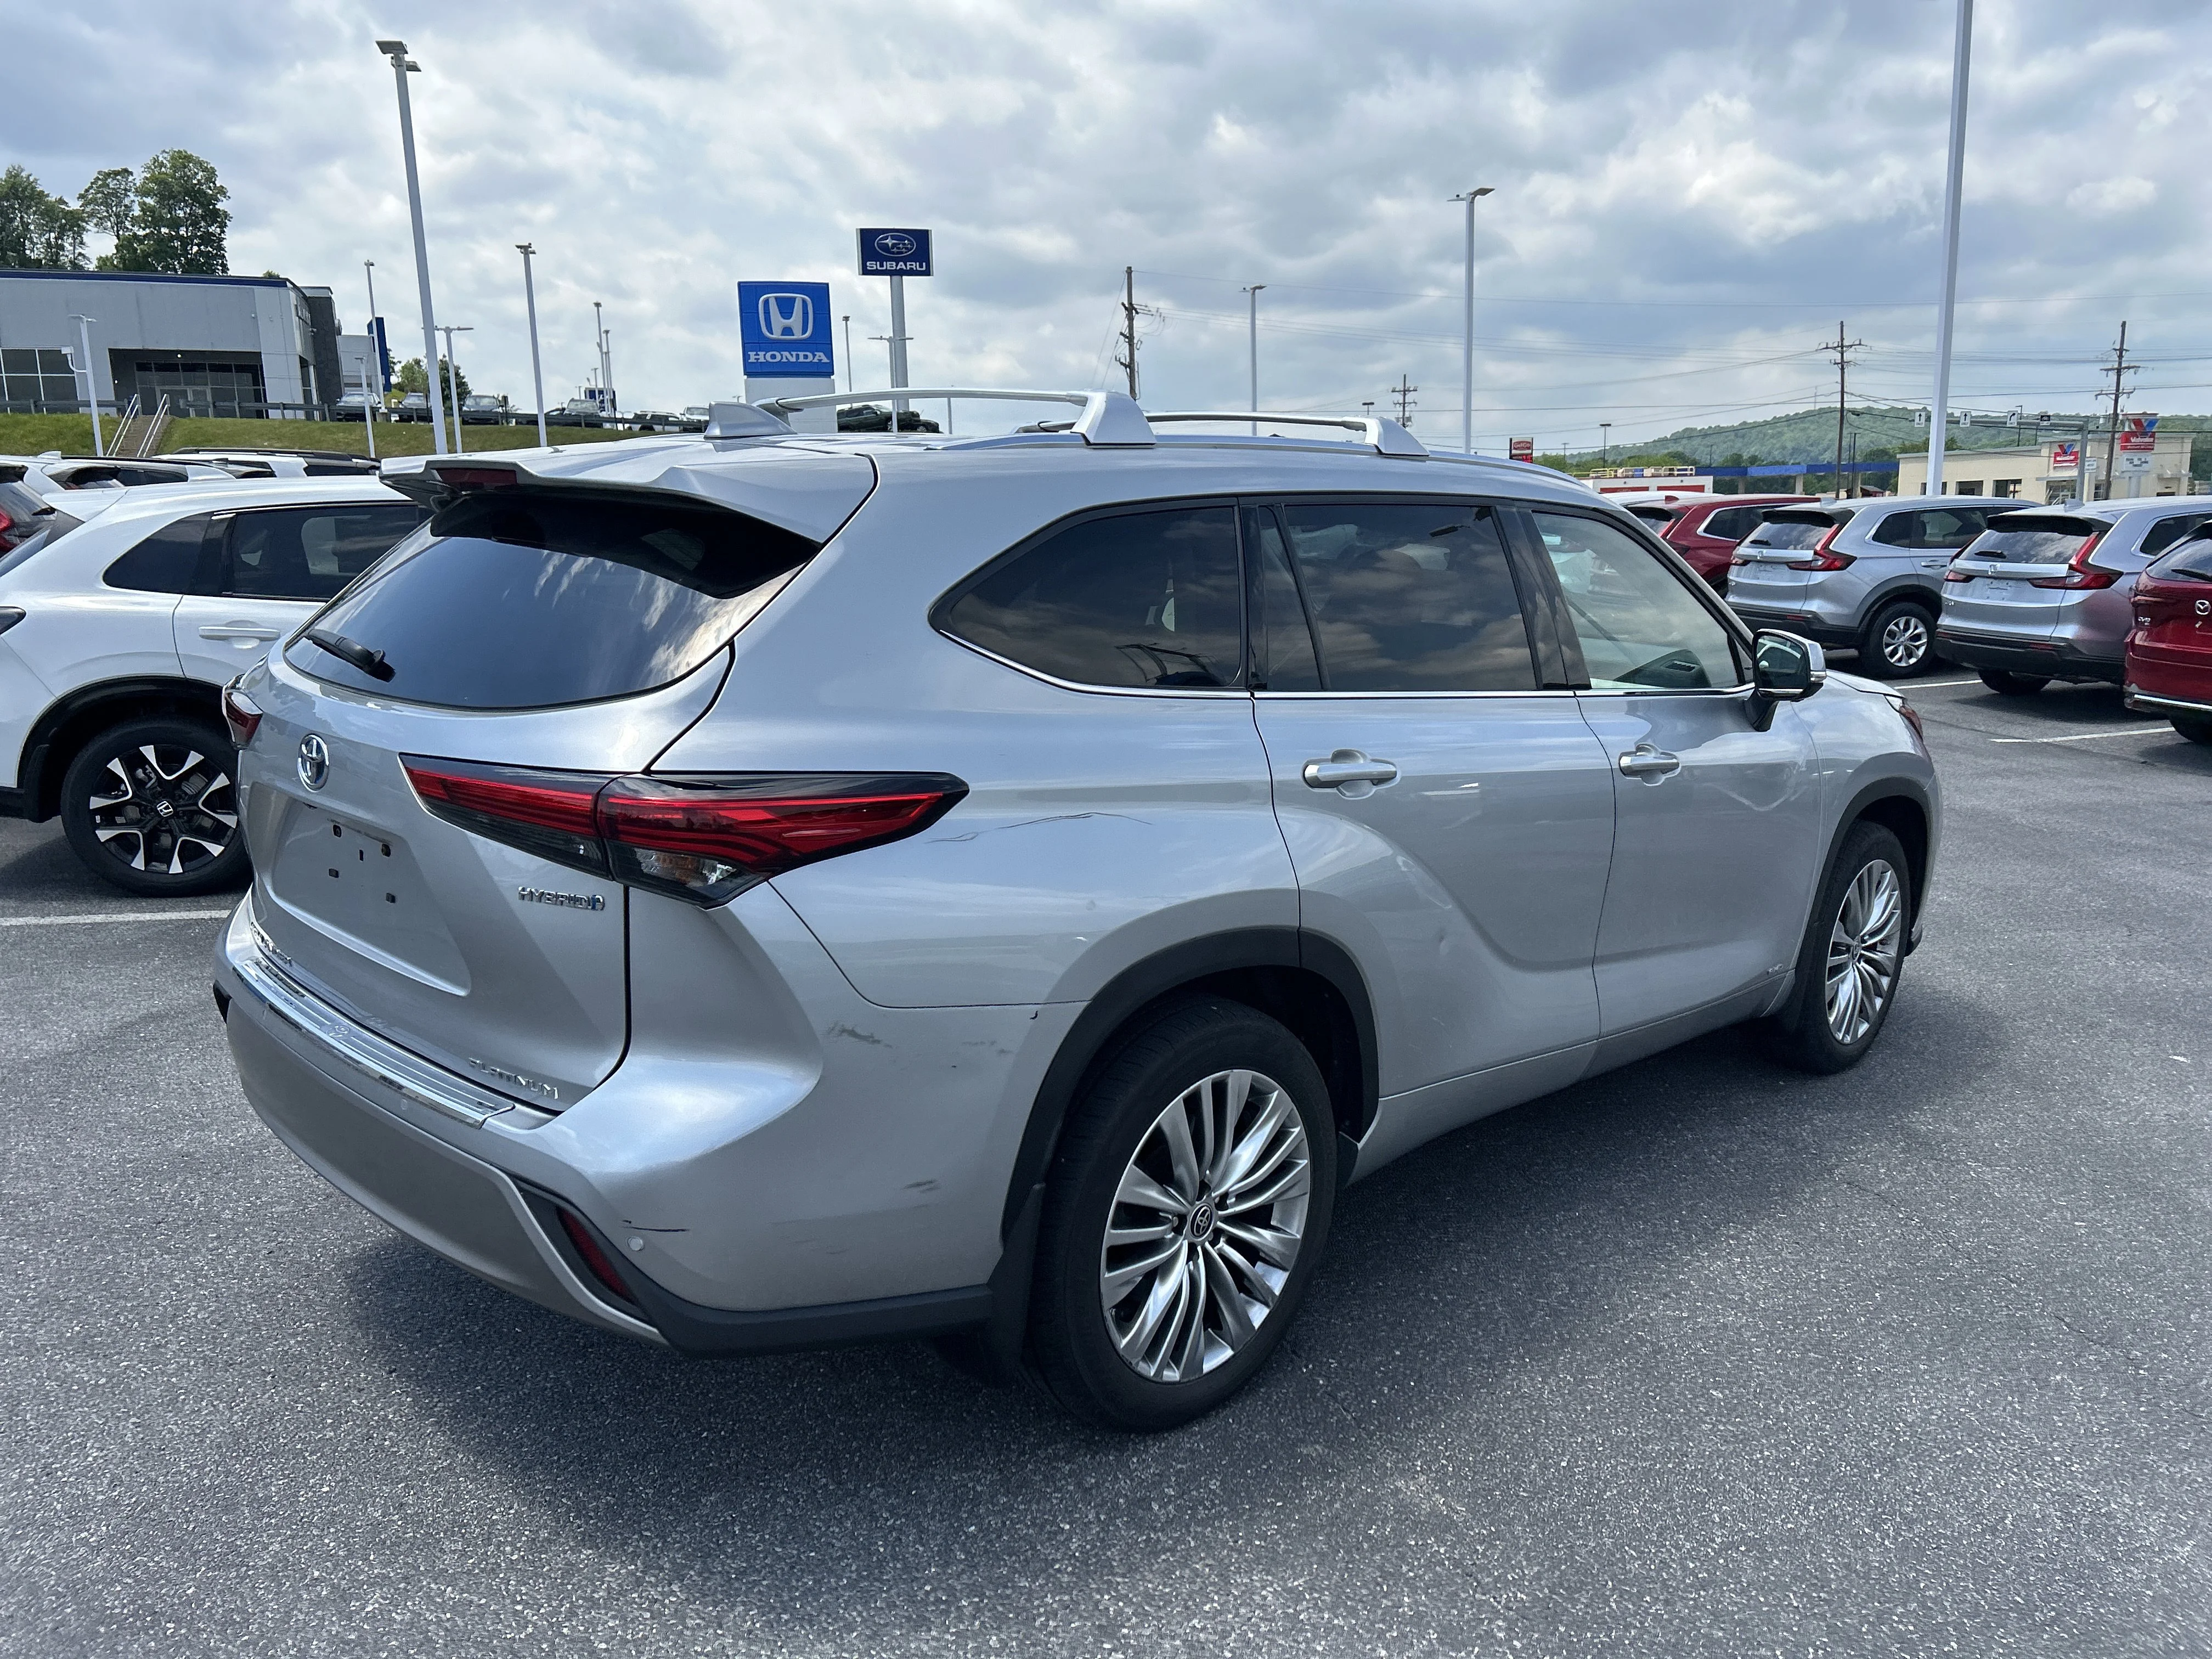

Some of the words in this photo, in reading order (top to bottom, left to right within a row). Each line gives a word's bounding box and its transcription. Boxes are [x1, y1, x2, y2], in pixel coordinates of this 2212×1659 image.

[866, 261, 926, 271] SUBARU
[747, 351, 830, 363] HONDA
[518, 886, 591, 909] HYBRID
